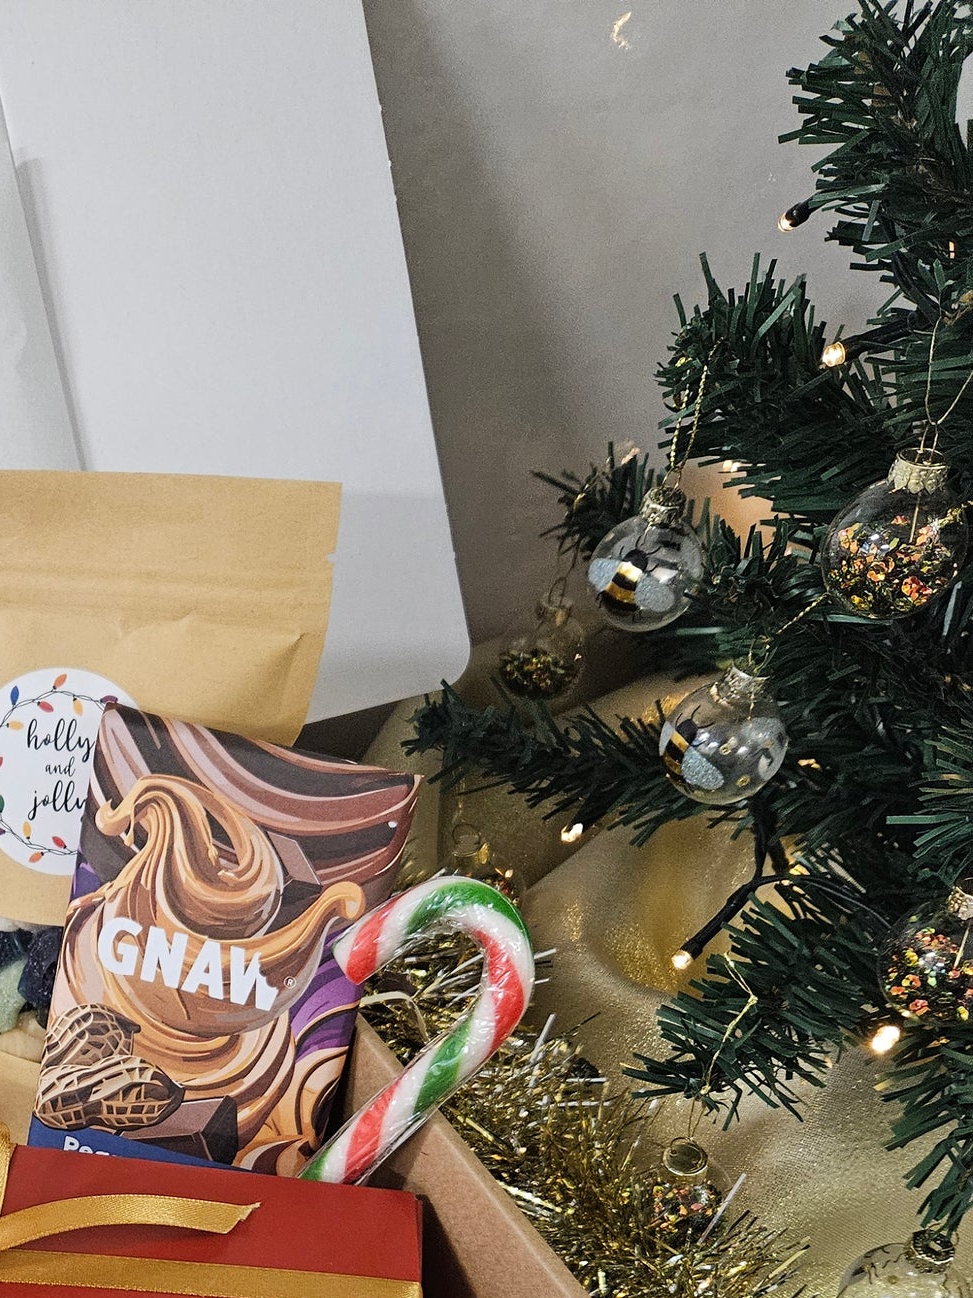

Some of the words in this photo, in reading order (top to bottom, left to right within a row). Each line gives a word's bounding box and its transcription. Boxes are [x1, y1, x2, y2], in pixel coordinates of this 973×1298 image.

[27, 718, 95, 763] holly
[45, 756, 76, 777] and
[97, 916, 279, 1012] GNAW
